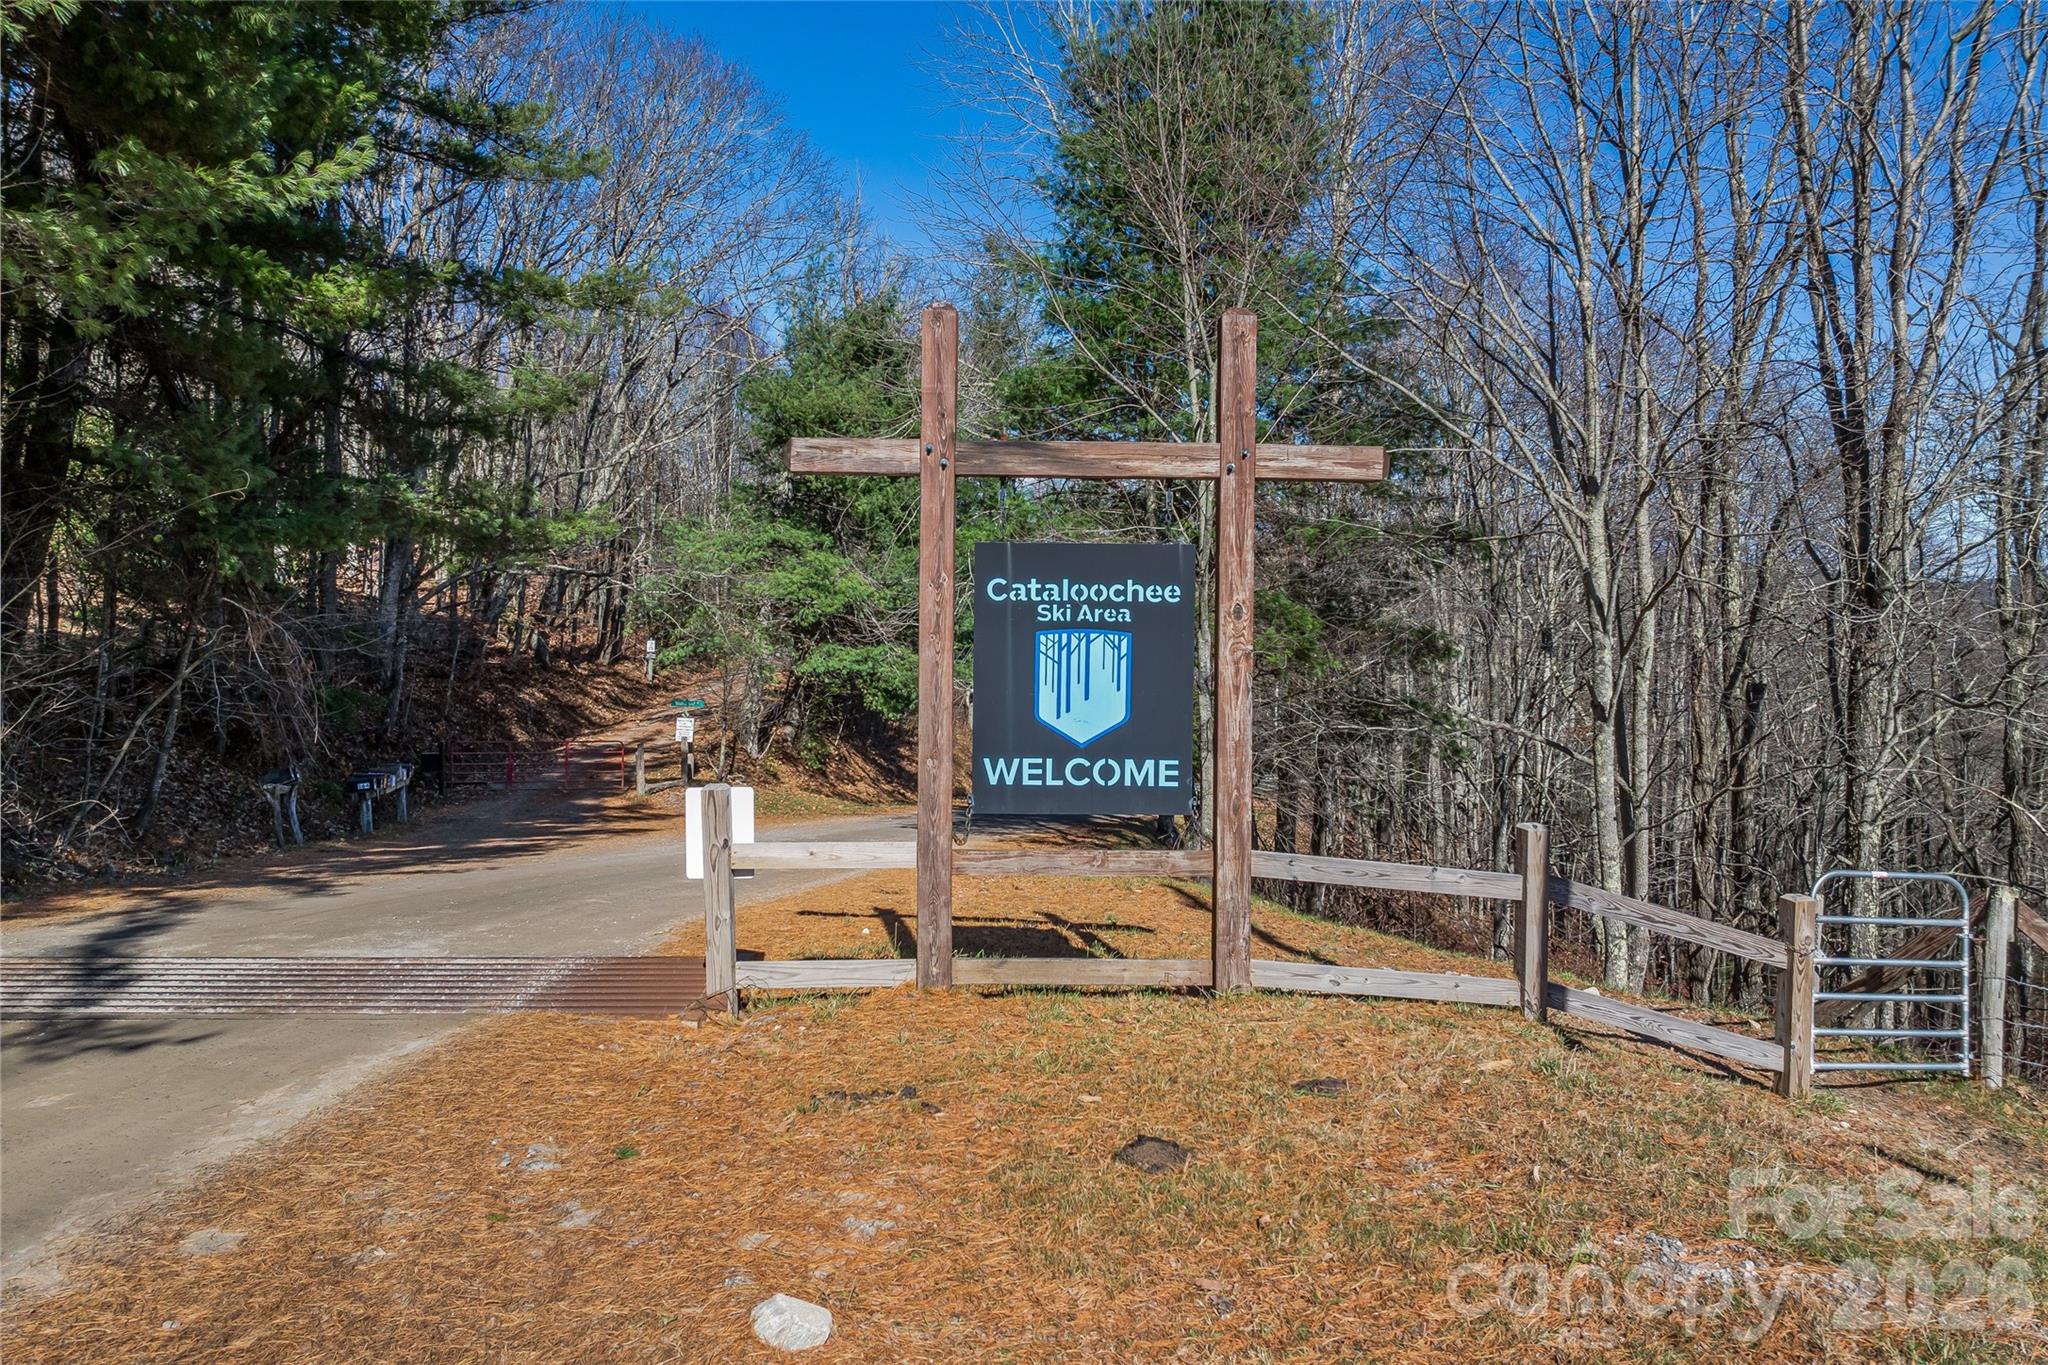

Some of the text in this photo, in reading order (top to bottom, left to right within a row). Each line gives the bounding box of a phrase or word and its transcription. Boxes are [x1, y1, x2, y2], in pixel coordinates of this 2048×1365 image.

[986, 577, 1182, 603] Cataloochee
[1036, 604, 1132, 622] Ski Area
[983, 757, 1180, 787] WELCOME
